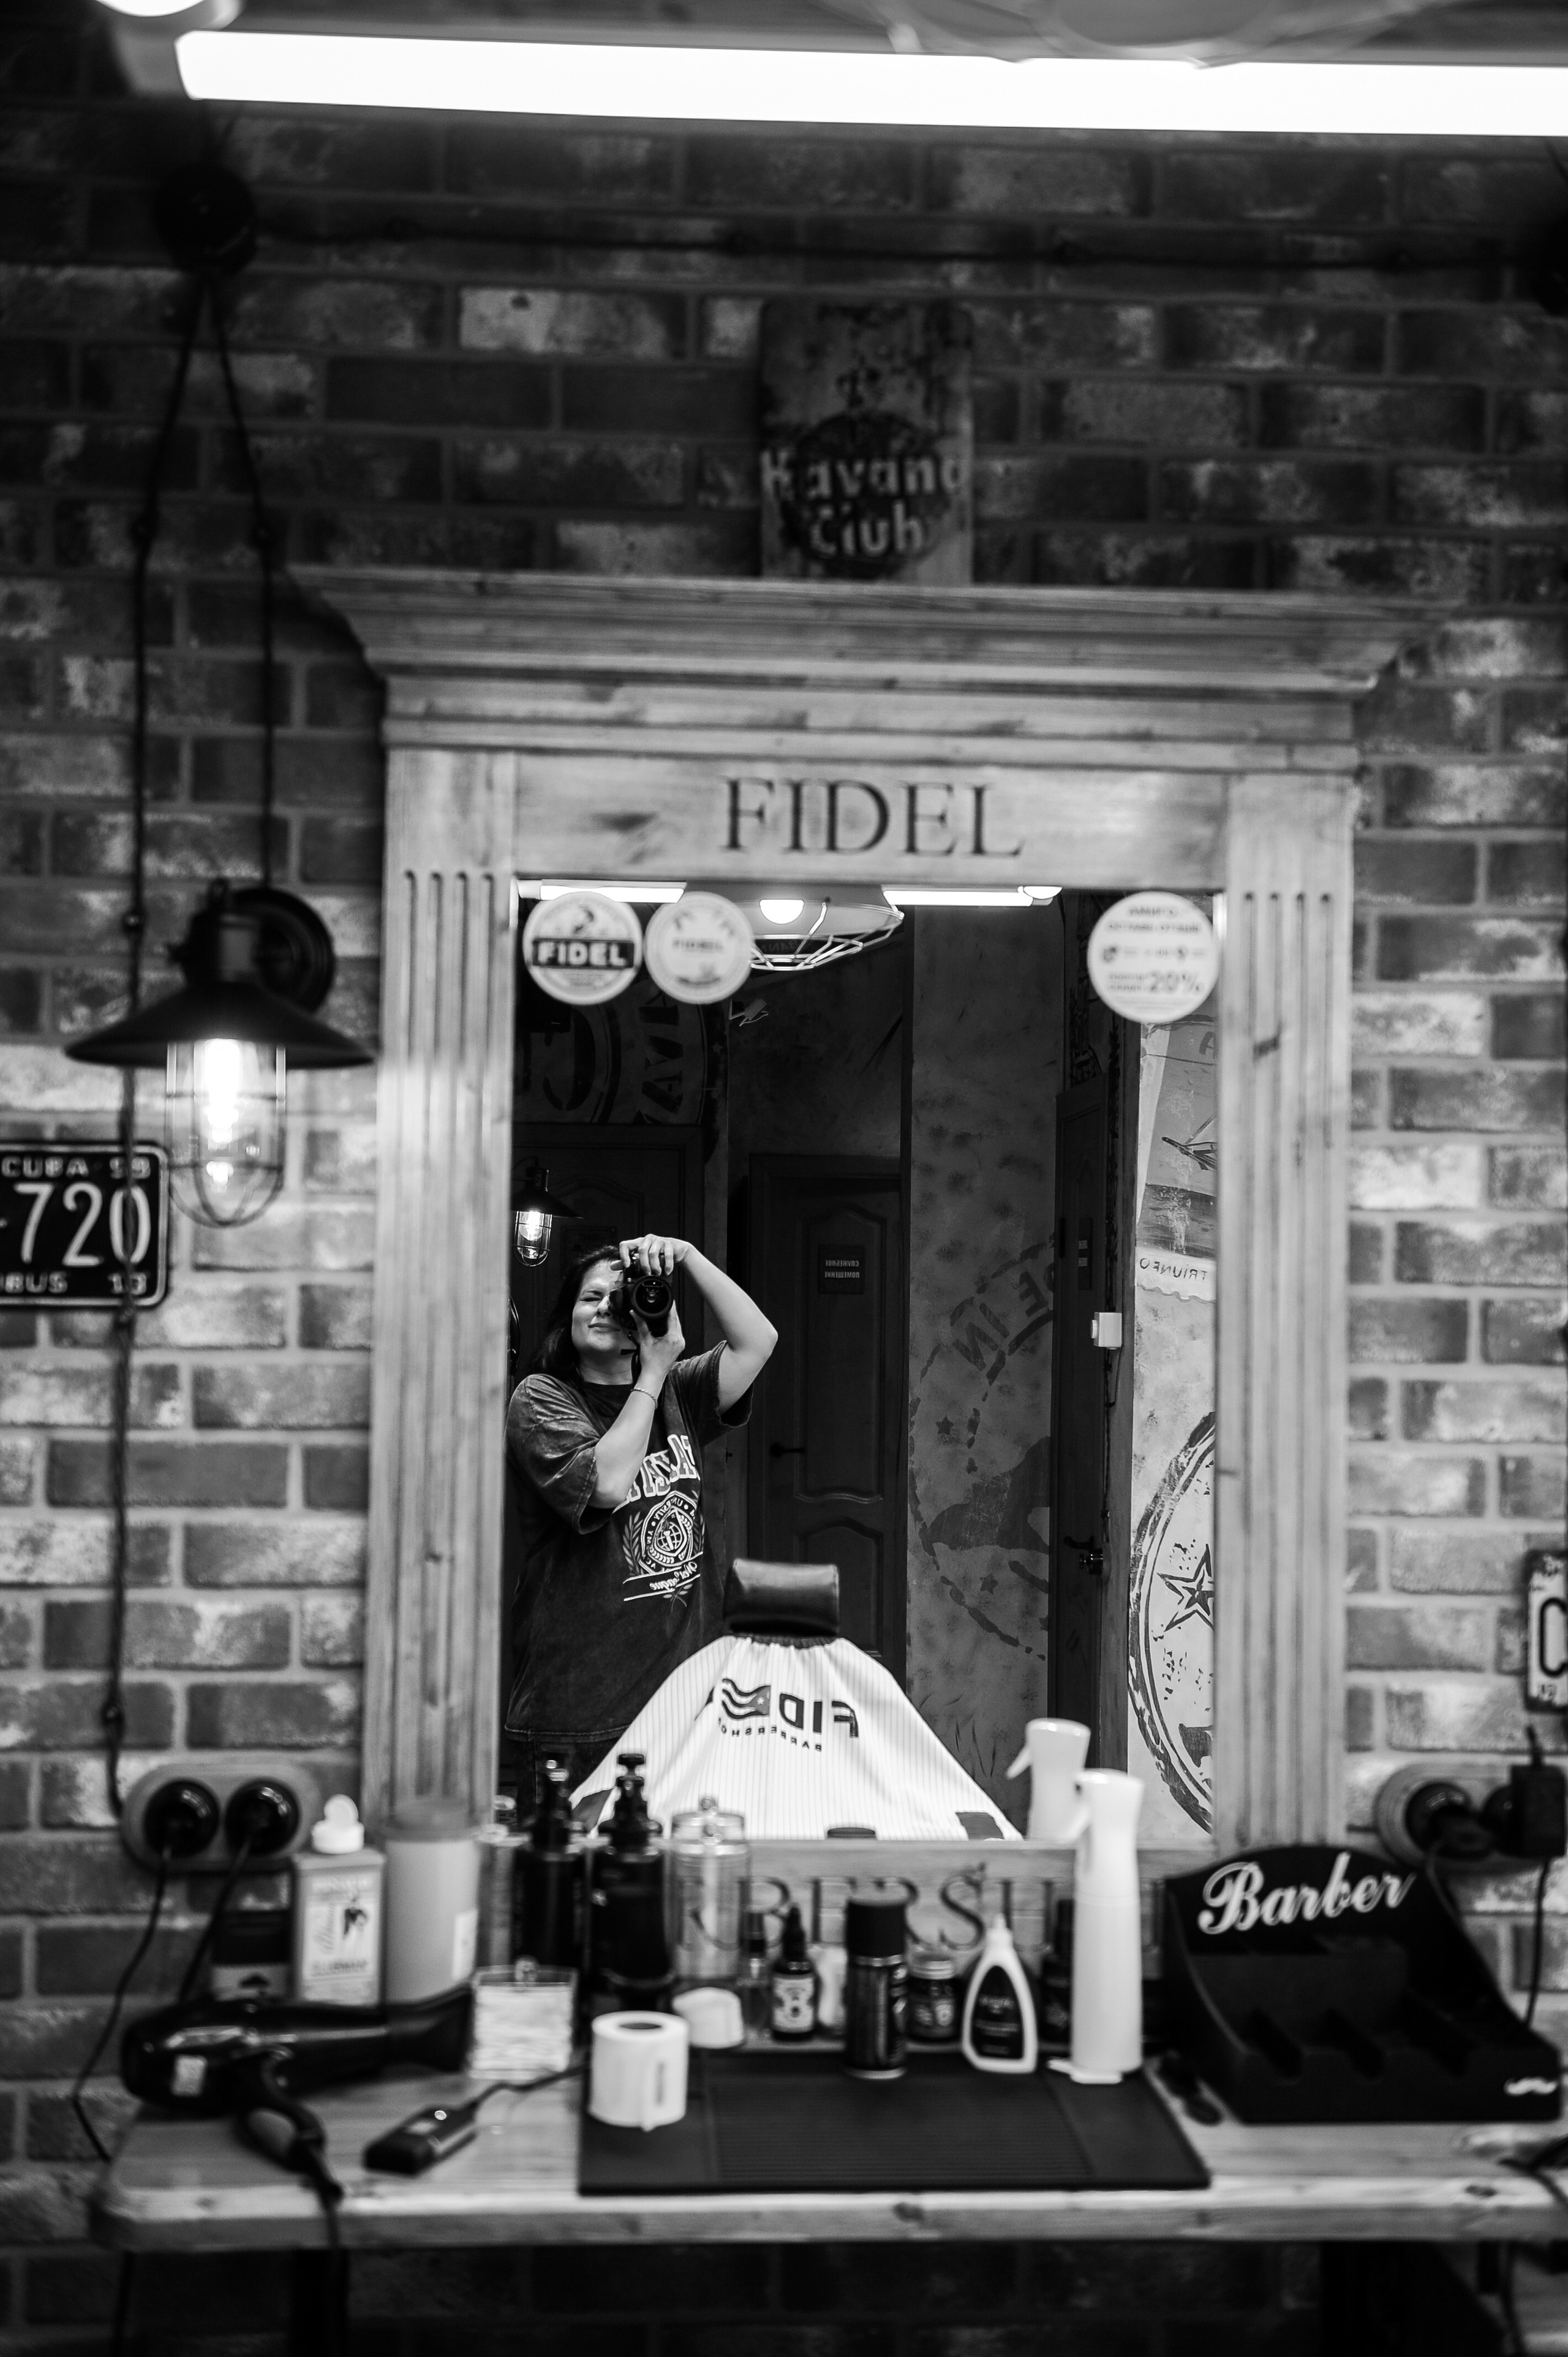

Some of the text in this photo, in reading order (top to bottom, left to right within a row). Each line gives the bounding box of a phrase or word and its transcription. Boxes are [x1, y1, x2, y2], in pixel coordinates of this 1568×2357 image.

[719, 777, 1027, 858] FIDEL
[537, 941, 627, 966] FIDEL
[1197, 1850, 1417, 1934] Barber
